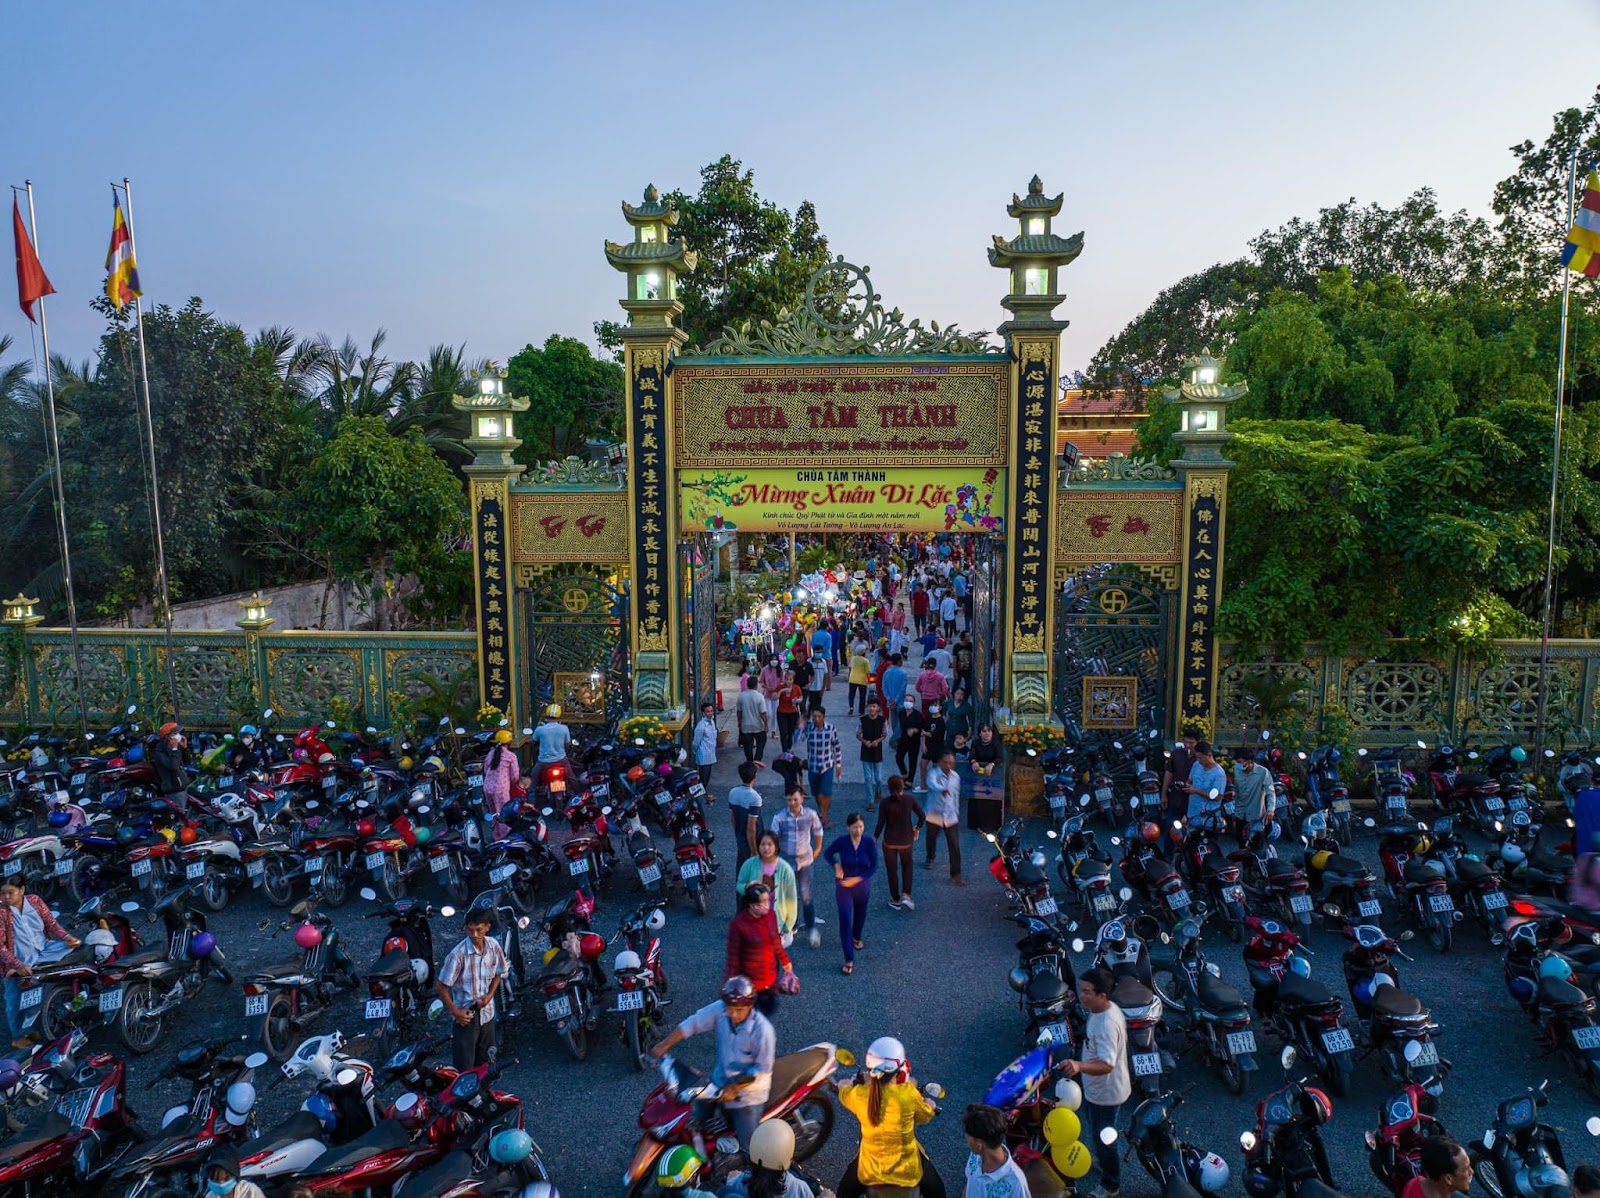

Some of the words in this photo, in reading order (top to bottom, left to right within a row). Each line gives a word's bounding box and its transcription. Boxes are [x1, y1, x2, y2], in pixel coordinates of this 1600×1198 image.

[908, 380, 938, 392] NAM
[725, 397, 790, 429] CHÙA
[807, 400, 859, 429] TÂM
[877, 398, 959, 428] THÀNH
[797, 469, 824, 482] CHÙA
[827, 470, 849, 482] TÂM
[852, 469, 886, 482] THÀNH
[732, 483, 810, 511] Mừng
[811, 482, 876, 506] Xuân
[880, 483, 915, 504] Di
[915, 483, 953, 510] Lặc
[762, 511, 778, 519] Kính
[779, 511, 794, 519] chúc
[811, 511, 826, 520] Phật
[836, 511, 845, 519] và
[846, 511, 858, 519] Gia
[860, 511, 875, 519] đình
[875, 511, 889, 520] một
[891, 511, 906, 519] năm
[907, 510, 921, 519] mới
[777, 521, 786, 529] Vô
[787, 521, 809, 530] Lượng
[810, 521, 821, 529] Cát
[823, 521, 843, 530] Tường
[849, 521, 858, 529] Vô
[859, 521, 881, 530] Lượng
[882, 521, 892, 529] An
[1136, 1053, 1156, 1065] 66-N1
